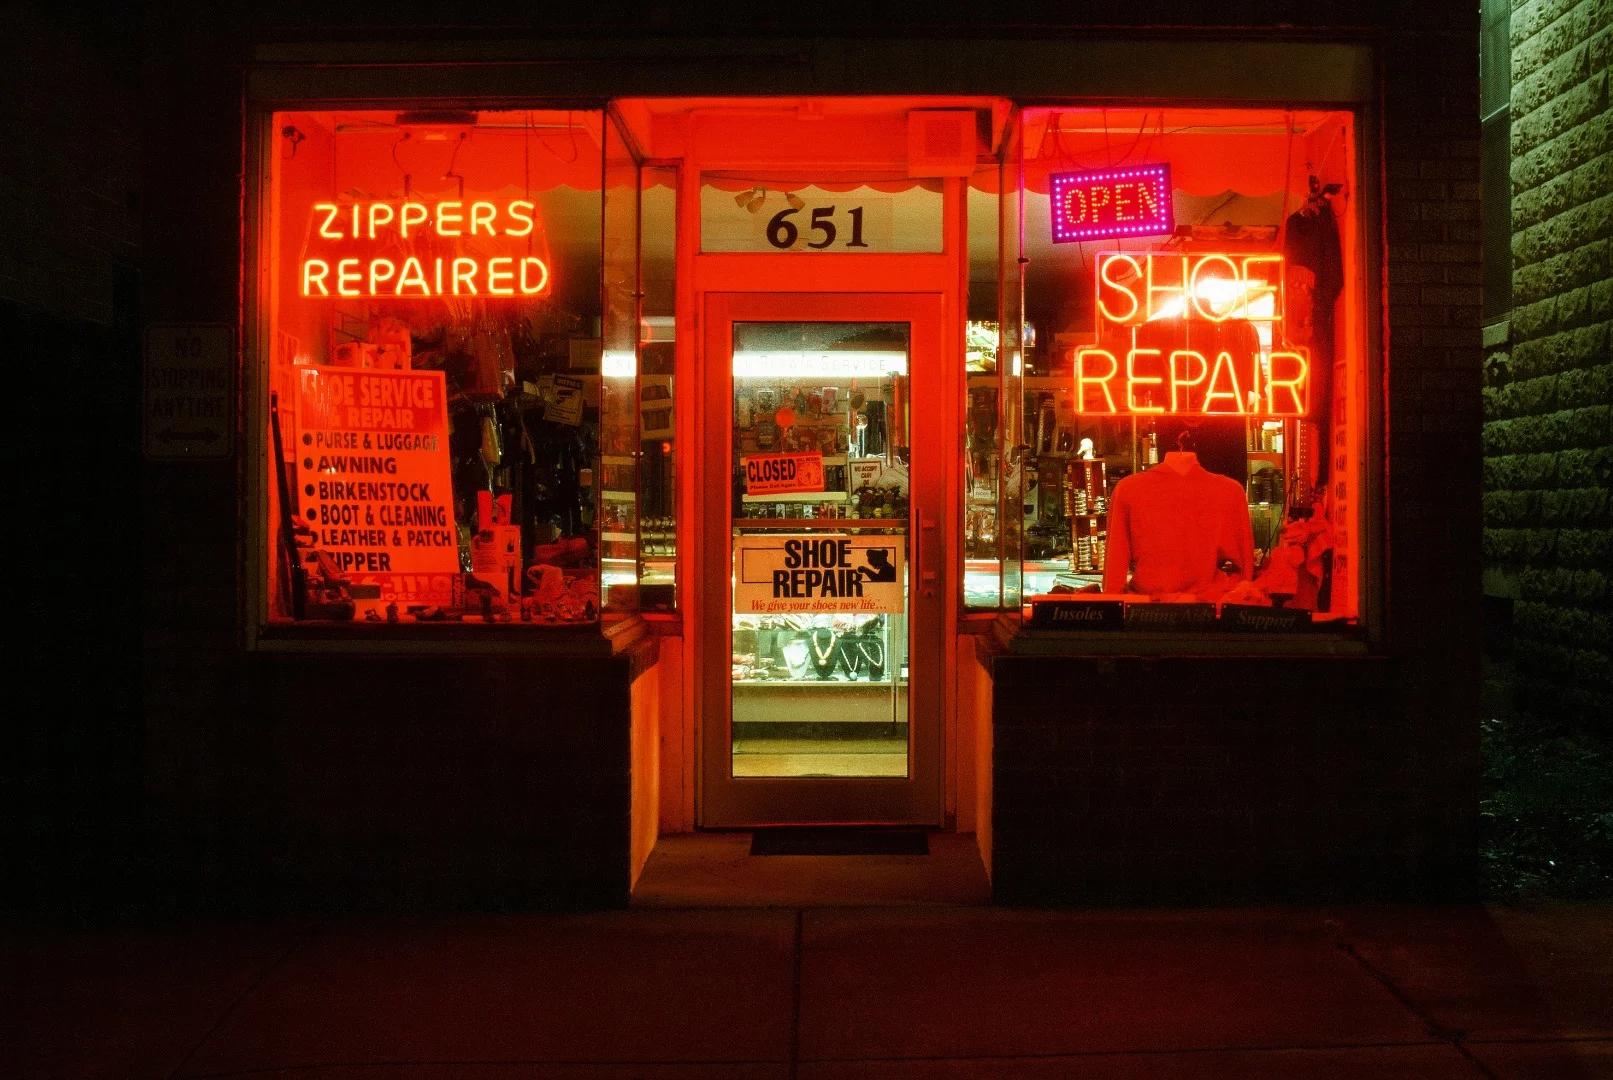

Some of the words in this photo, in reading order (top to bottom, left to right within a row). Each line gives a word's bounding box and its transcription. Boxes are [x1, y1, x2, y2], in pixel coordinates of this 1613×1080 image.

[1064, 181, 1158, 223] OPEN
[314, 200, 534, 239] ZIPPERS
[766, 205, 868, 249] 651
[302, 257, 548, 296] REPAIRED
[1098, 253, 1283, 322] SHOE
[174, 336, 202, 358] NO
[151, 367, 227, 389] STOPPING
[1077, 349, 1308, 414] REPAIR
[360, 375, 435, 408] SERVICE
[152, 397, 227, 418] ANYTIME
[347, 407, 415, 429] REPAIR
[316, 431, 358, 449] PURSE
[363, 433, 373, 450] &
[317, 455, 397, 474] AWNING
[748, 459, 796, 482] CLOSED
[319, 481, 431, 501] BIRKENSTOCK
[320, 504, 359, 526] BOOT
[365, 504, 375, 526] &
[379, 505, 447, 527] CLEANING
[321, 529, 387, 547] LEATHER
[392, 530, 402, 547] &
[407, 530, 452, 547] PATCH
[784, 539, 852, 569] SHOE
[773, 569, 864, 598] REPAIR
[751, 600, 765, 610] We
[767, 600, 786, 613] give
[787, 602, 811, 612] your
[812, 600, 837, 611] shoes
[840, 602, 857, 610] new
[1053, 606, 1104, 621] Insoles
[1238, 609, 1296, 629] Support
